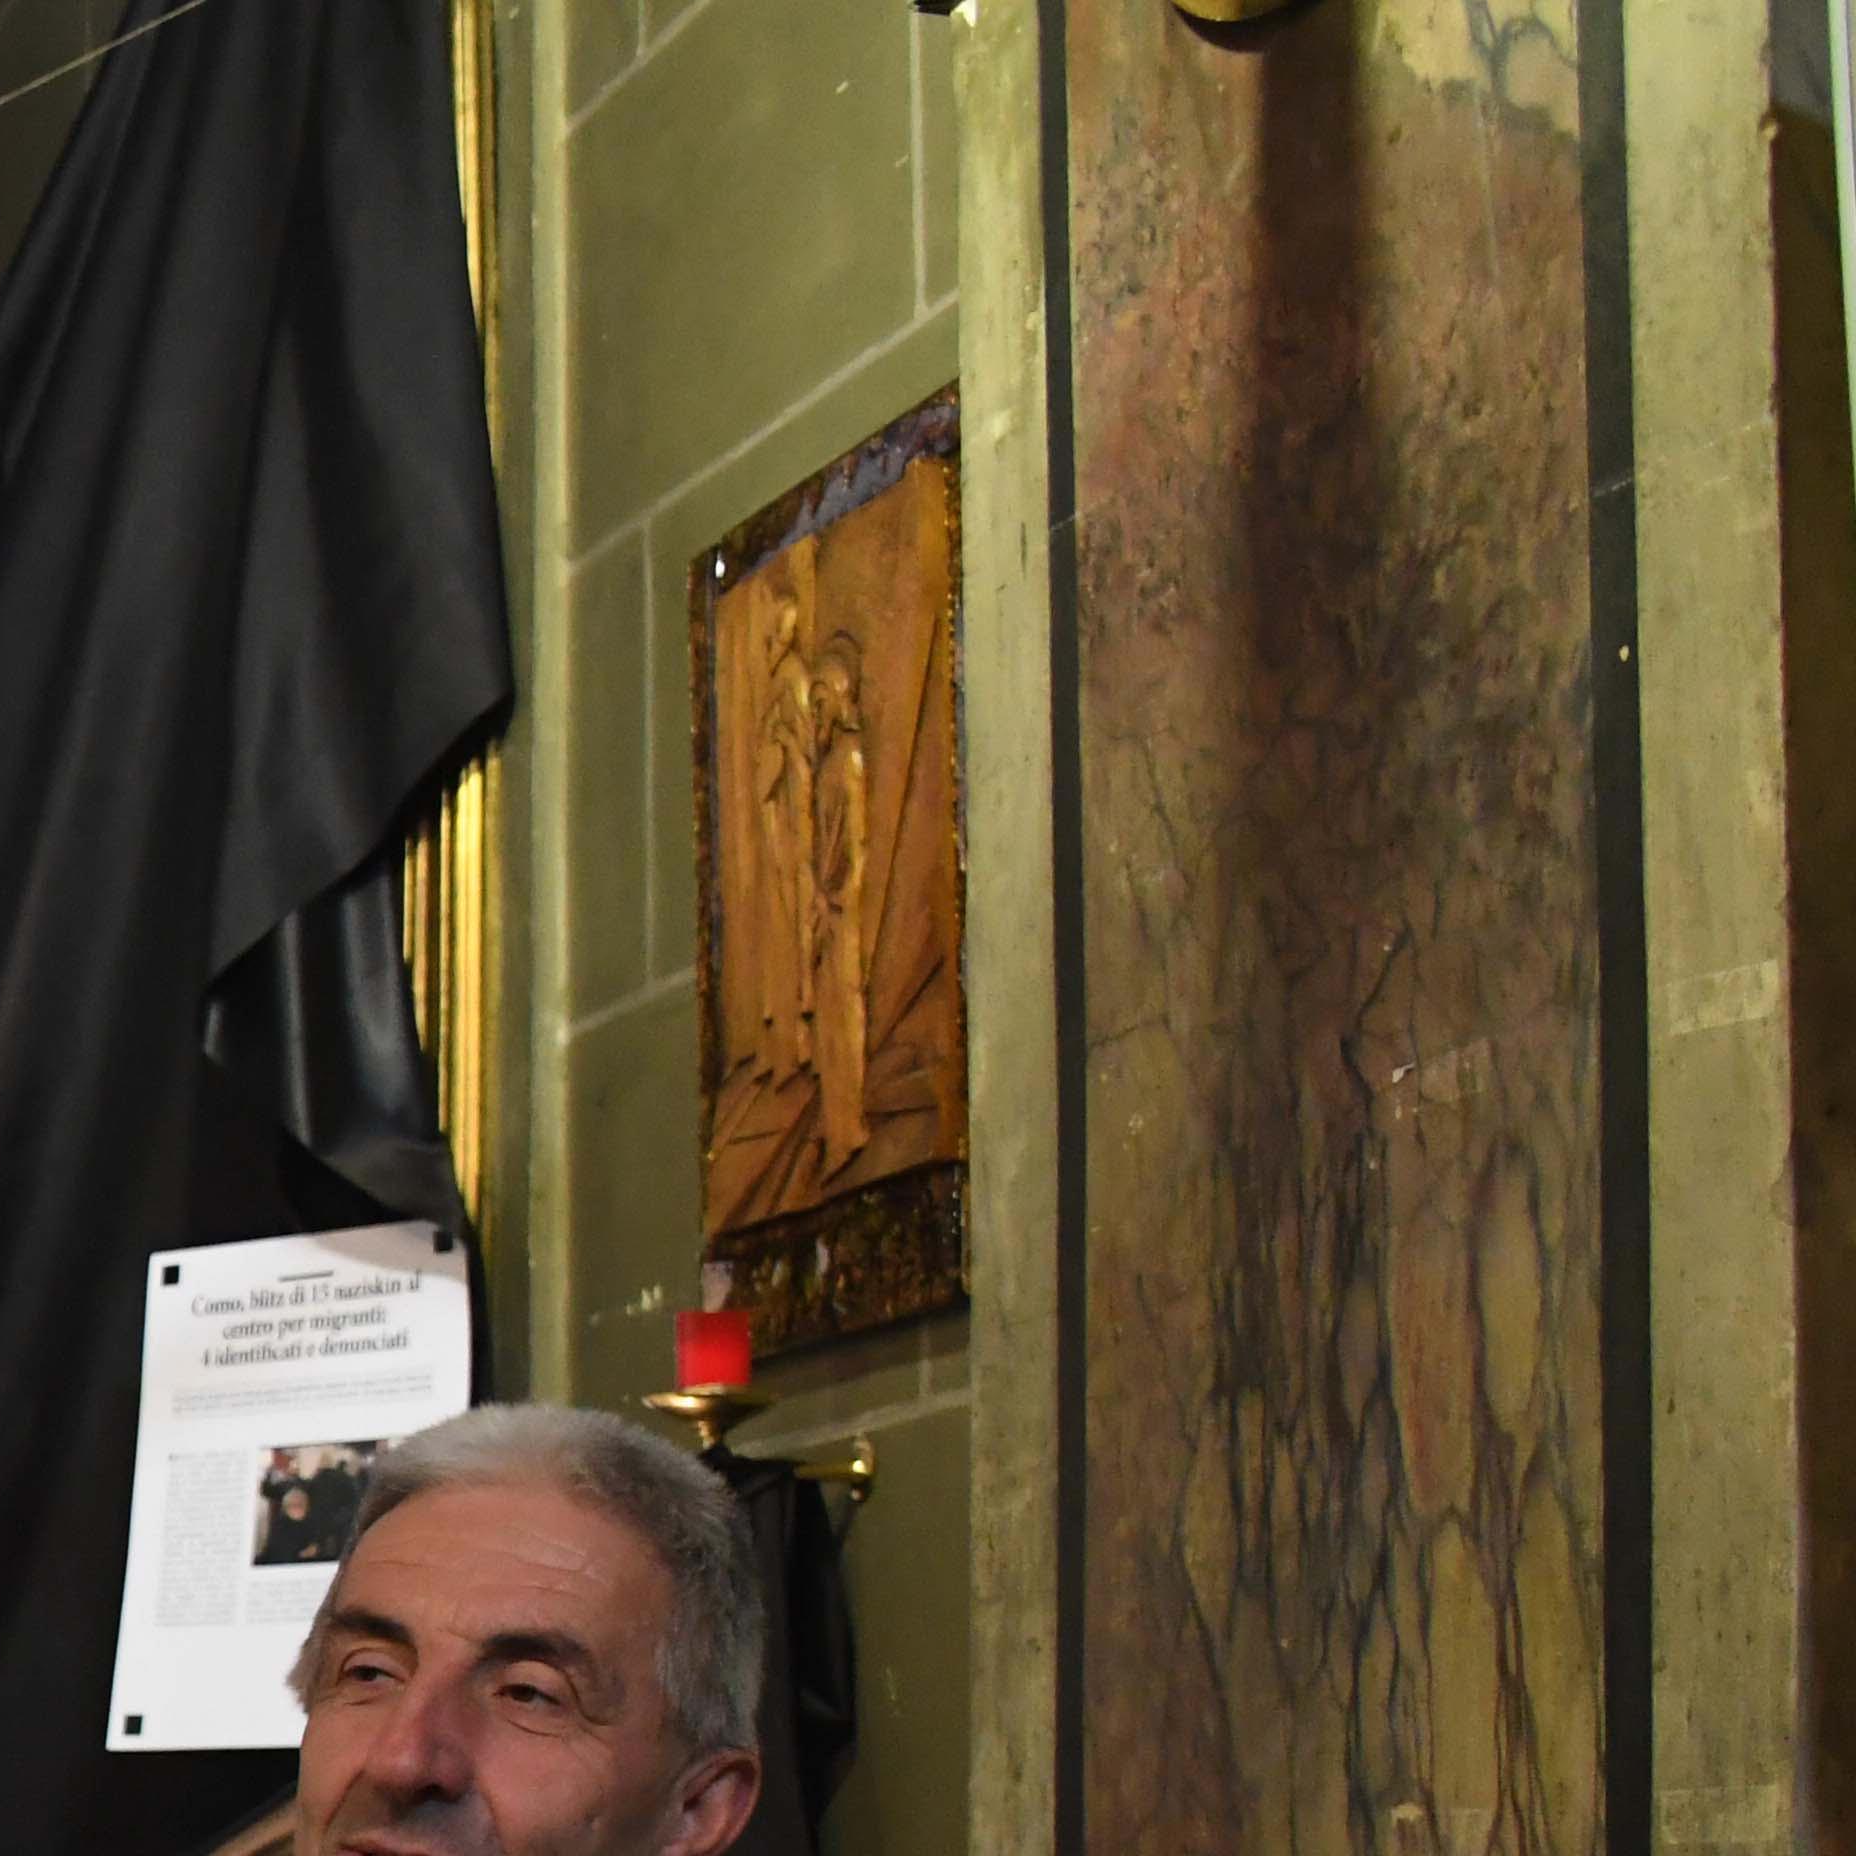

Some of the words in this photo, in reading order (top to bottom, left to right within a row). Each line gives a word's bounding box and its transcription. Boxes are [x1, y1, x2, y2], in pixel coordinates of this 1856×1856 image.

[249, 1289, 285, 1310] blitz
[334, 1276, 401, 1301] naziskin
[221, 1320, 274, 1340] centro
[277, 1317, 307, 1339] per
[214, 1340, 303, 1366] identificati
[318, 1329, 409, 1356] denunciati
